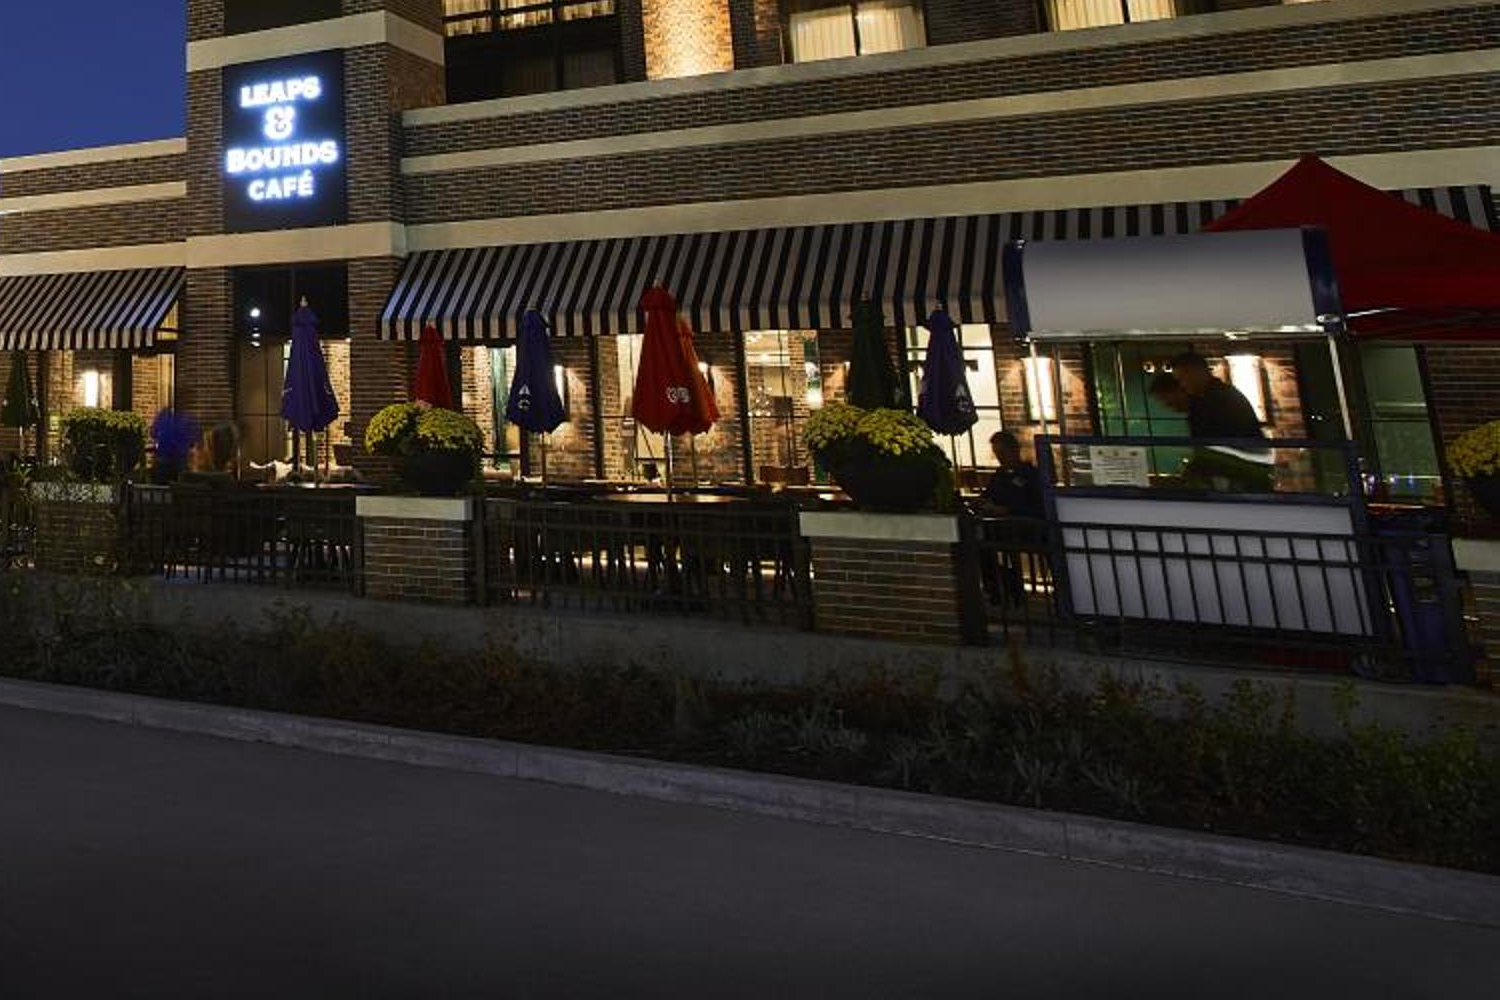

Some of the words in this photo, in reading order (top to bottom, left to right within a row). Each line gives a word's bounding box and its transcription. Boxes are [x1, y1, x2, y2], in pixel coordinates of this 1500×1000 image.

[239, 75, 322, 108] LEAPS
[264, 105, 295, 140] &
[226, 140, 338, 173] BOUNDS
[248, 168, 315, 201] CAFÉ
